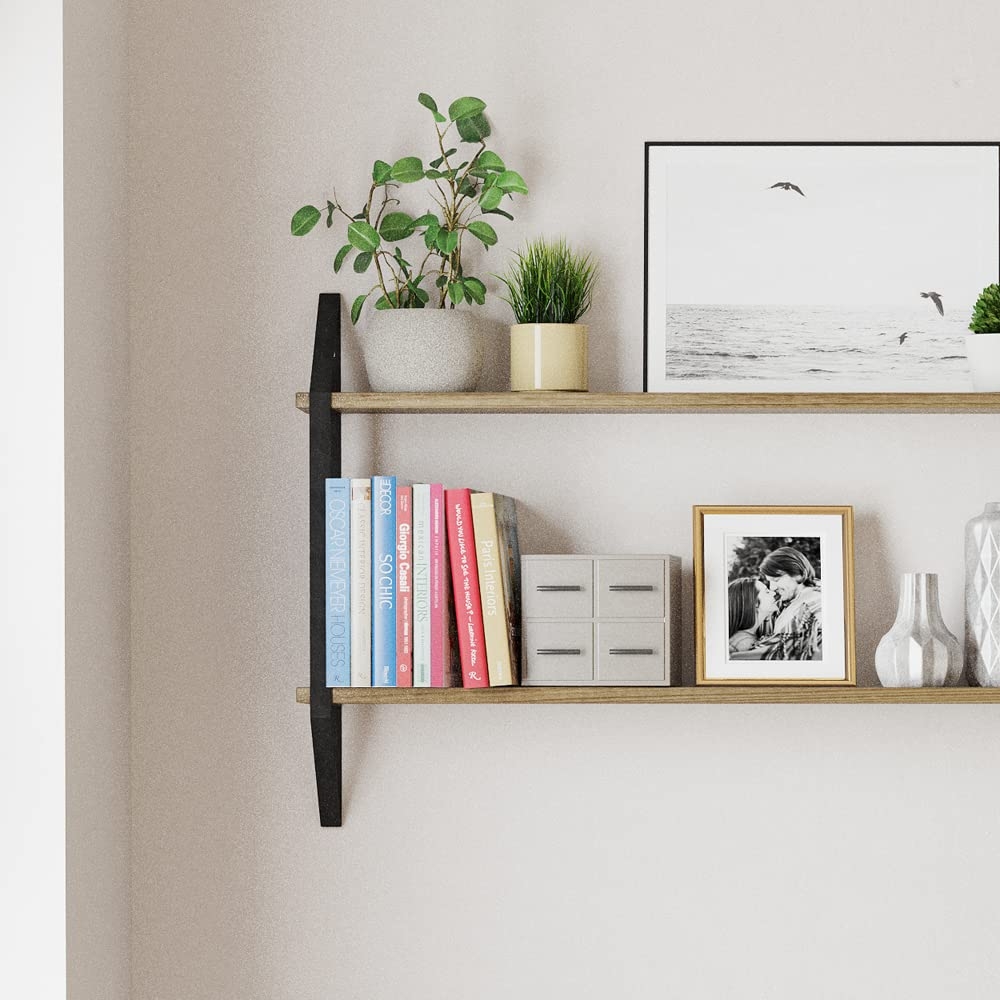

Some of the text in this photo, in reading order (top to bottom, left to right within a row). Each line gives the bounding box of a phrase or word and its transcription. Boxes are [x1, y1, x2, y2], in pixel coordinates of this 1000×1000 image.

[397, 523, 410, 560] Giorgio
[461, 555, 467, 564] TO
[329, 498, 346, 667] OSCAR NIEMEYER HOUSES
[378, 553, 393, 610] SO CHIC
[399, 562, 410, 593] Casali
[416, 520, 428, 623] mexican INTERIORS
[480, 540, 498, 617] Paris Interiors
